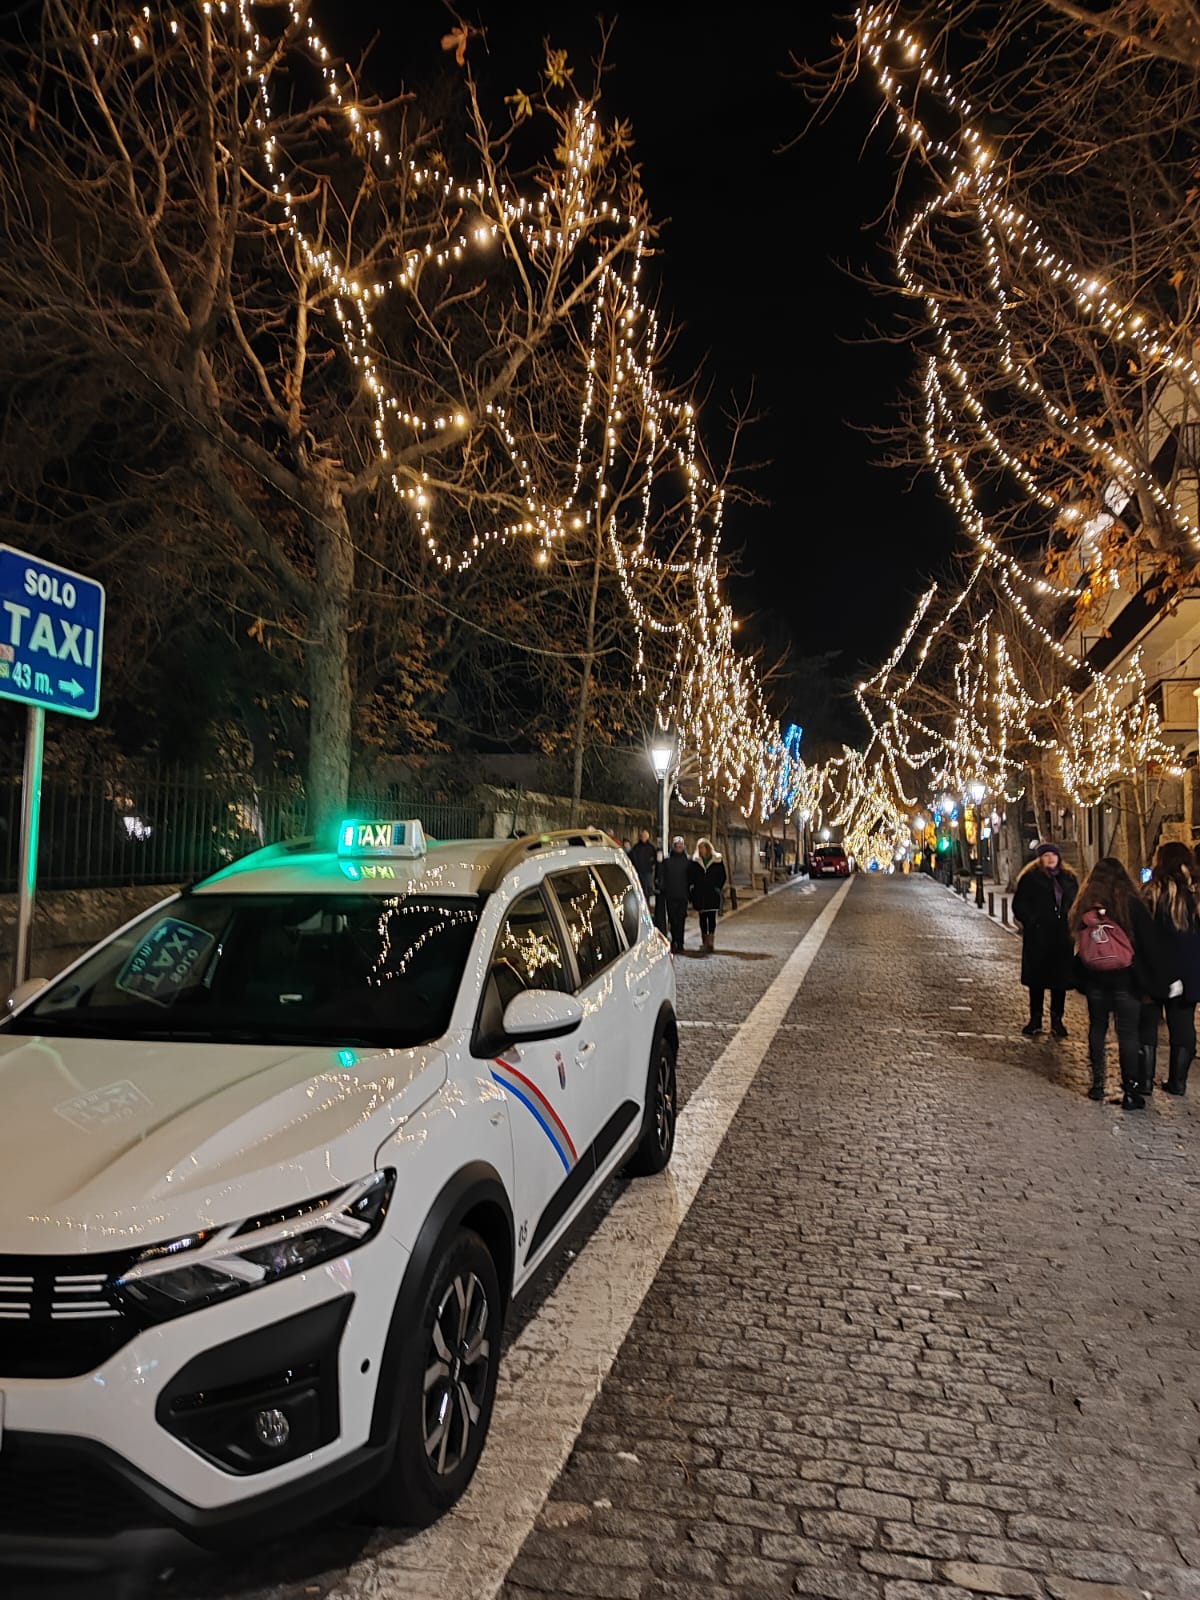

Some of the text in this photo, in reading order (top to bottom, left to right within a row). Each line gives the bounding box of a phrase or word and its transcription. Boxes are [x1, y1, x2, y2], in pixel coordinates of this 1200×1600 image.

[24, 568, 76, 609] SOLO
[3, 600, 94, 668] TAXI
[12, 661, 31, 690] 43
[34, 672, 53, 695] m.
[358, 824, 392, 847] TAXI
